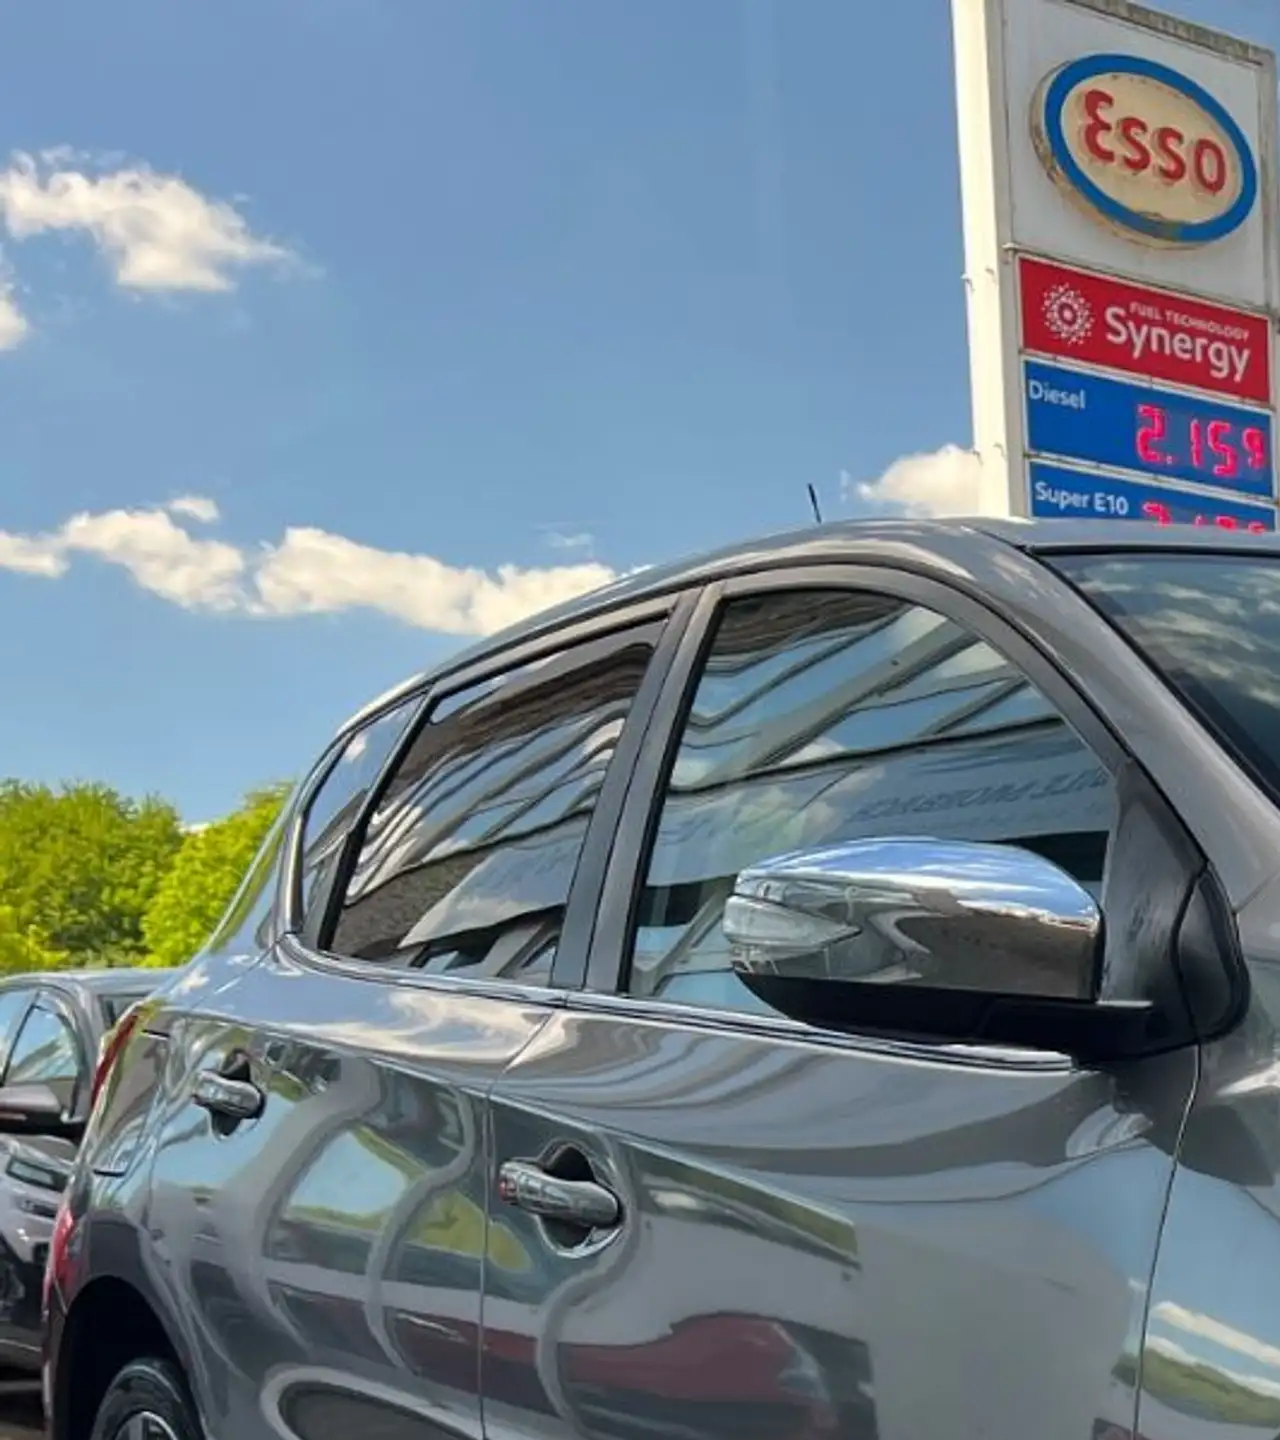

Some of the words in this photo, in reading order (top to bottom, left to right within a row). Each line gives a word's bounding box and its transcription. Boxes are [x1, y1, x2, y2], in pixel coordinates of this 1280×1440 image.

[1129, 301, 1162, 321] FUEL
[1165, 310, 1250, 342] TECHNOLOGY
[1104, 305, 1250, 383] Synergy
[1028, 379, 1086, 410] Diesel
[1035, 481, 1089, 511] Super
[1094, 493, 1130, 515] E10
